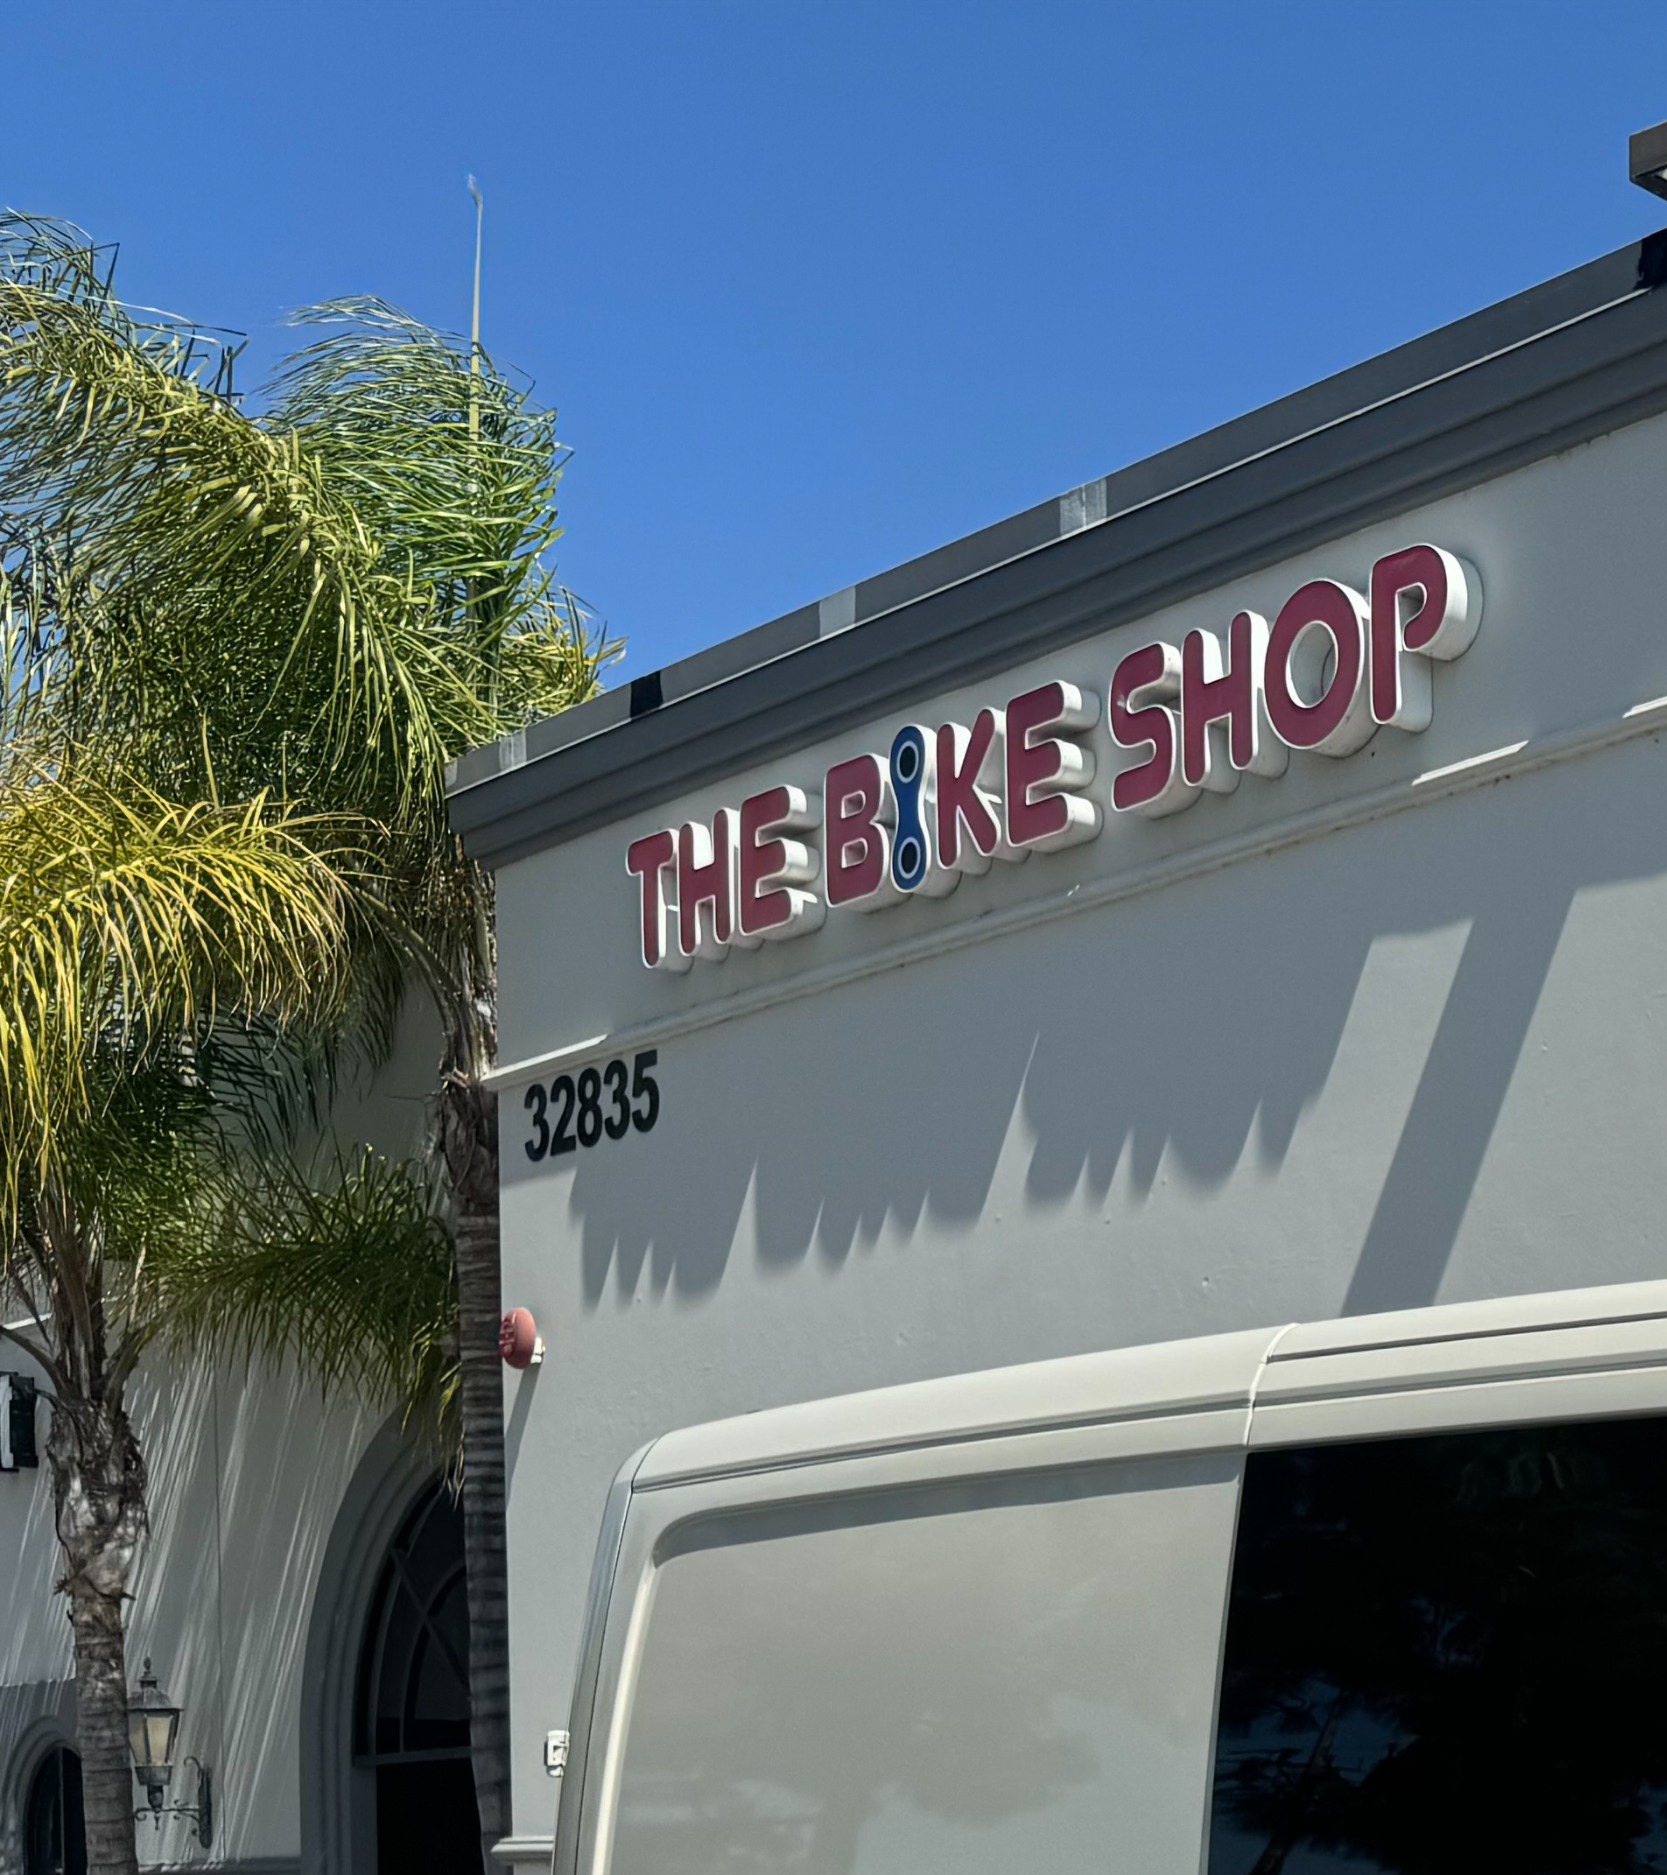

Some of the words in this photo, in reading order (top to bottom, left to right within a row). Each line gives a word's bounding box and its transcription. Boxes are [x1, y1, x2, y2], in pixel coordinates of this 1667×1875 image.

[626, 784, 827, 973] THE
[823, 679, 1103, 914] BIKE
[1108, 543, 1482, 818] SHOP
[524, 1050, 660, 1162] 32835
